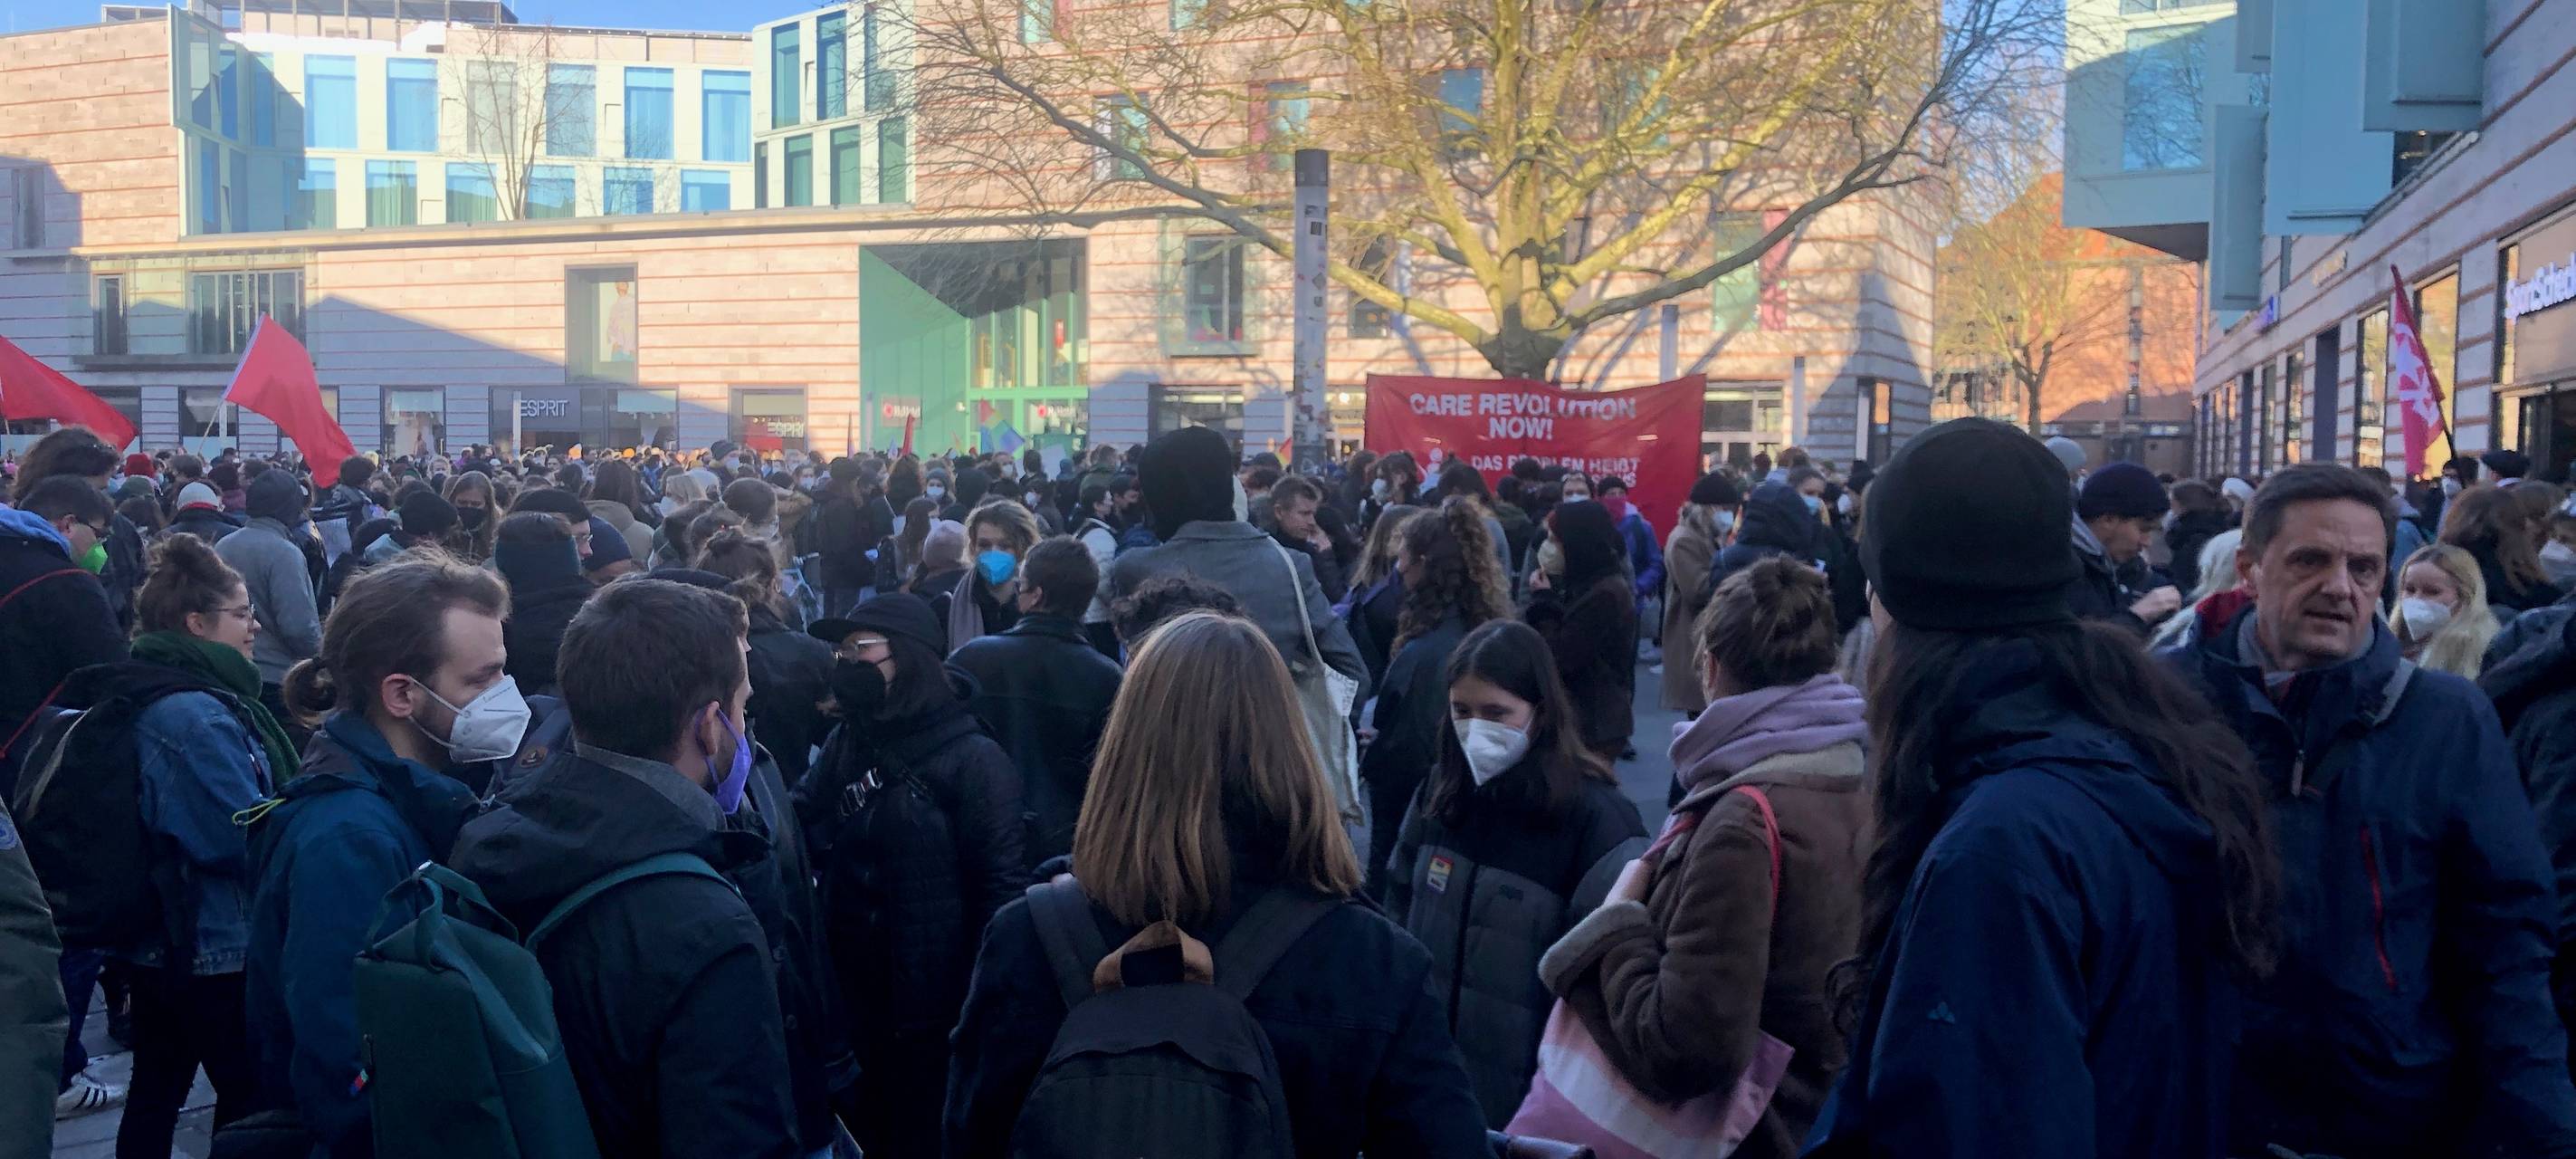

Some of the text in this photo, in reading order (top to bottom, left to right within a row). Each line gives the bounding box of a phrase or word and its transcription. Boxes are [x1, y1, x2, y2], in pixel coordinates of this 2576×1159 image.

[520, 399, 568, 417] ESPRIT
[1410, 393, 1636, 421] CARE REVOLUTION
[1489, 417, 1553, 439] NOW!
[1472, 455, 1503, 471] DAS
